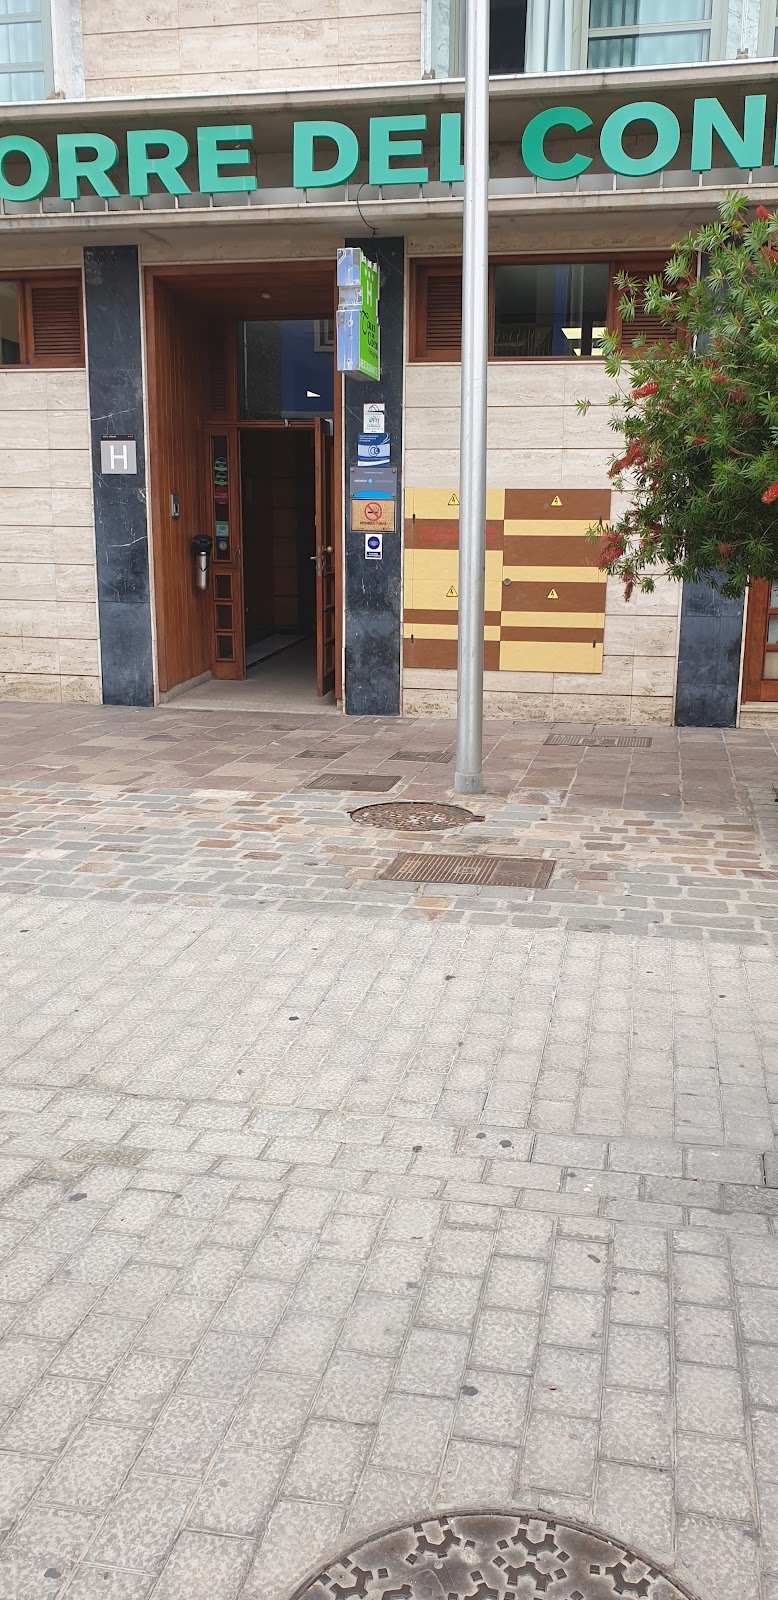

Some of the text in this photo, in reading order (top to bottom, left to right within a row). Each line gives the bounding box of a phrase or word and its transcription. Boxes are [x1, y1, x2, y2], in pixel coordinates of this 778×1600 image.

[293, 112, 465, 190] DEL
[521, 94, 778, 181] CON
[366, 280, 373, 307] H
[110, 444, 128, 470] H
